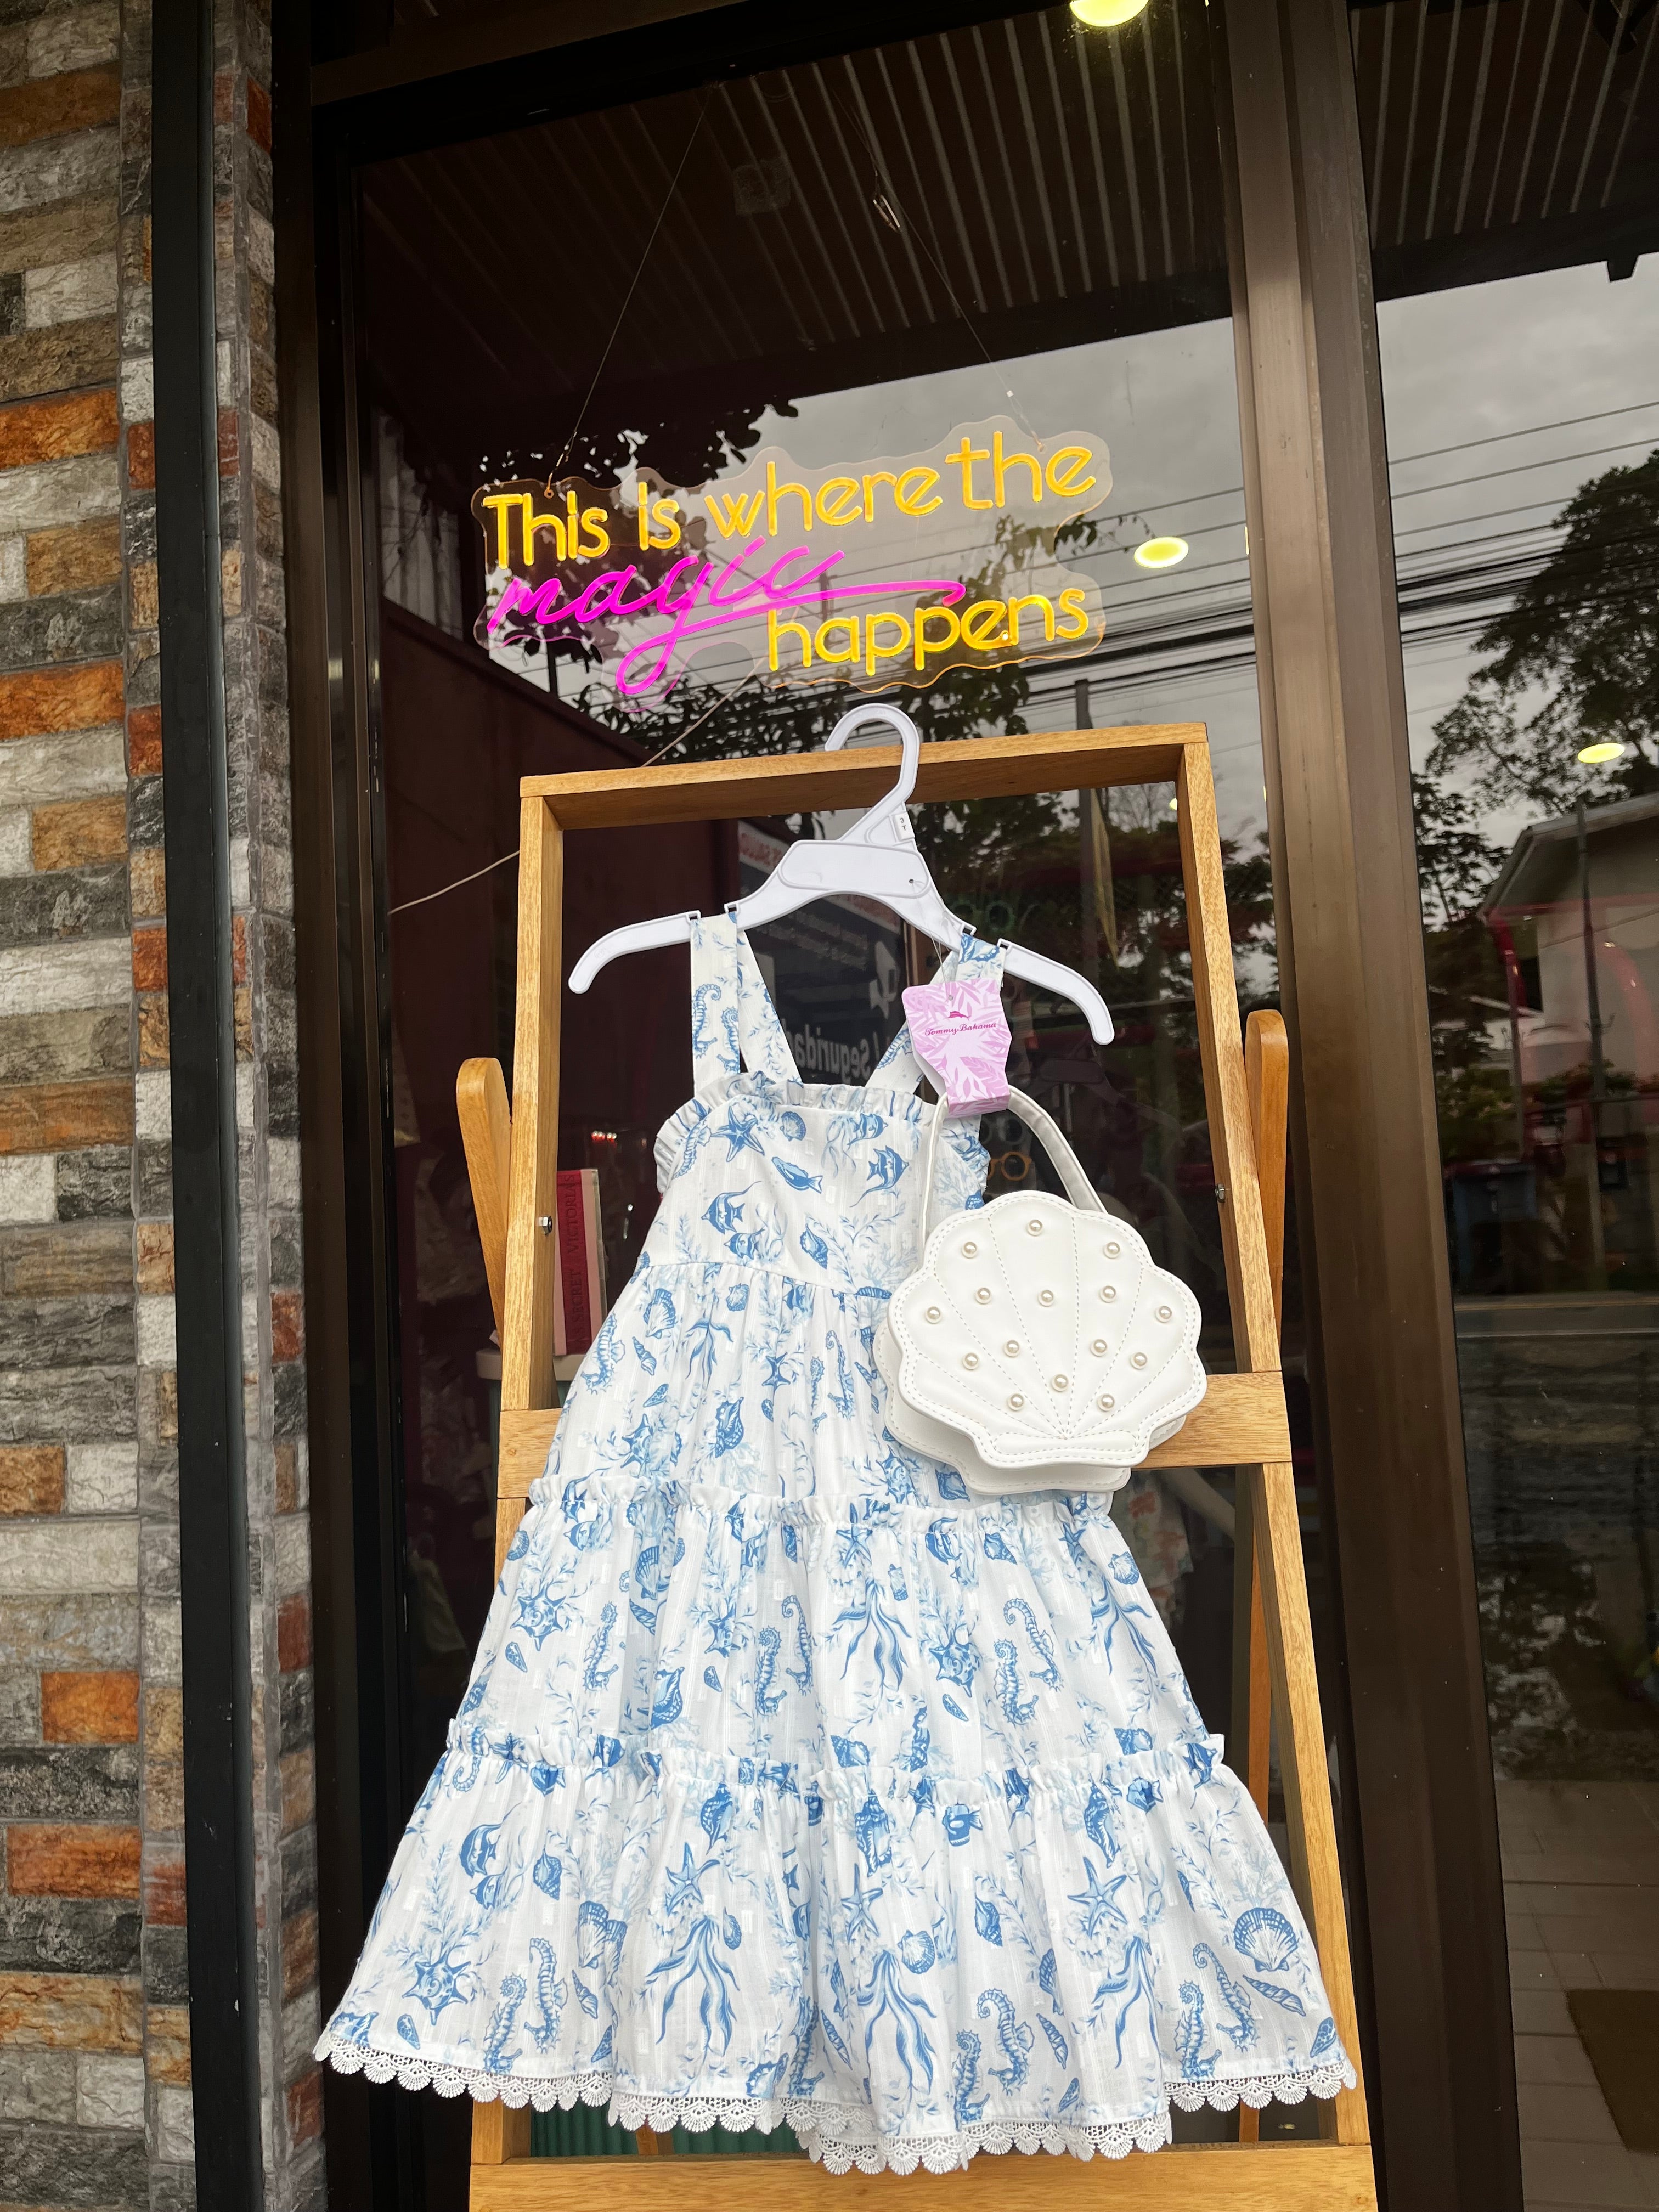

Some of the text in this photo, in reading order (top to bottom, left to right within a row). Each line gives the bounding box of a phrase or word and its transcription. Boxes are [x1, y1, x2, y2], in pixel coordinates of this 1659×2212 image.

[483, 492, 611, 569] This
[704, 461, 943, 539] where
[945, 431, 1096, 509] the
[486, 536, 967, 696] magic
[768, 588, 1089, 676] happens
[924, 1023, 997, 1036] Tommy Bahama
[565, 1175, 580, 1255] VICTORIAS
